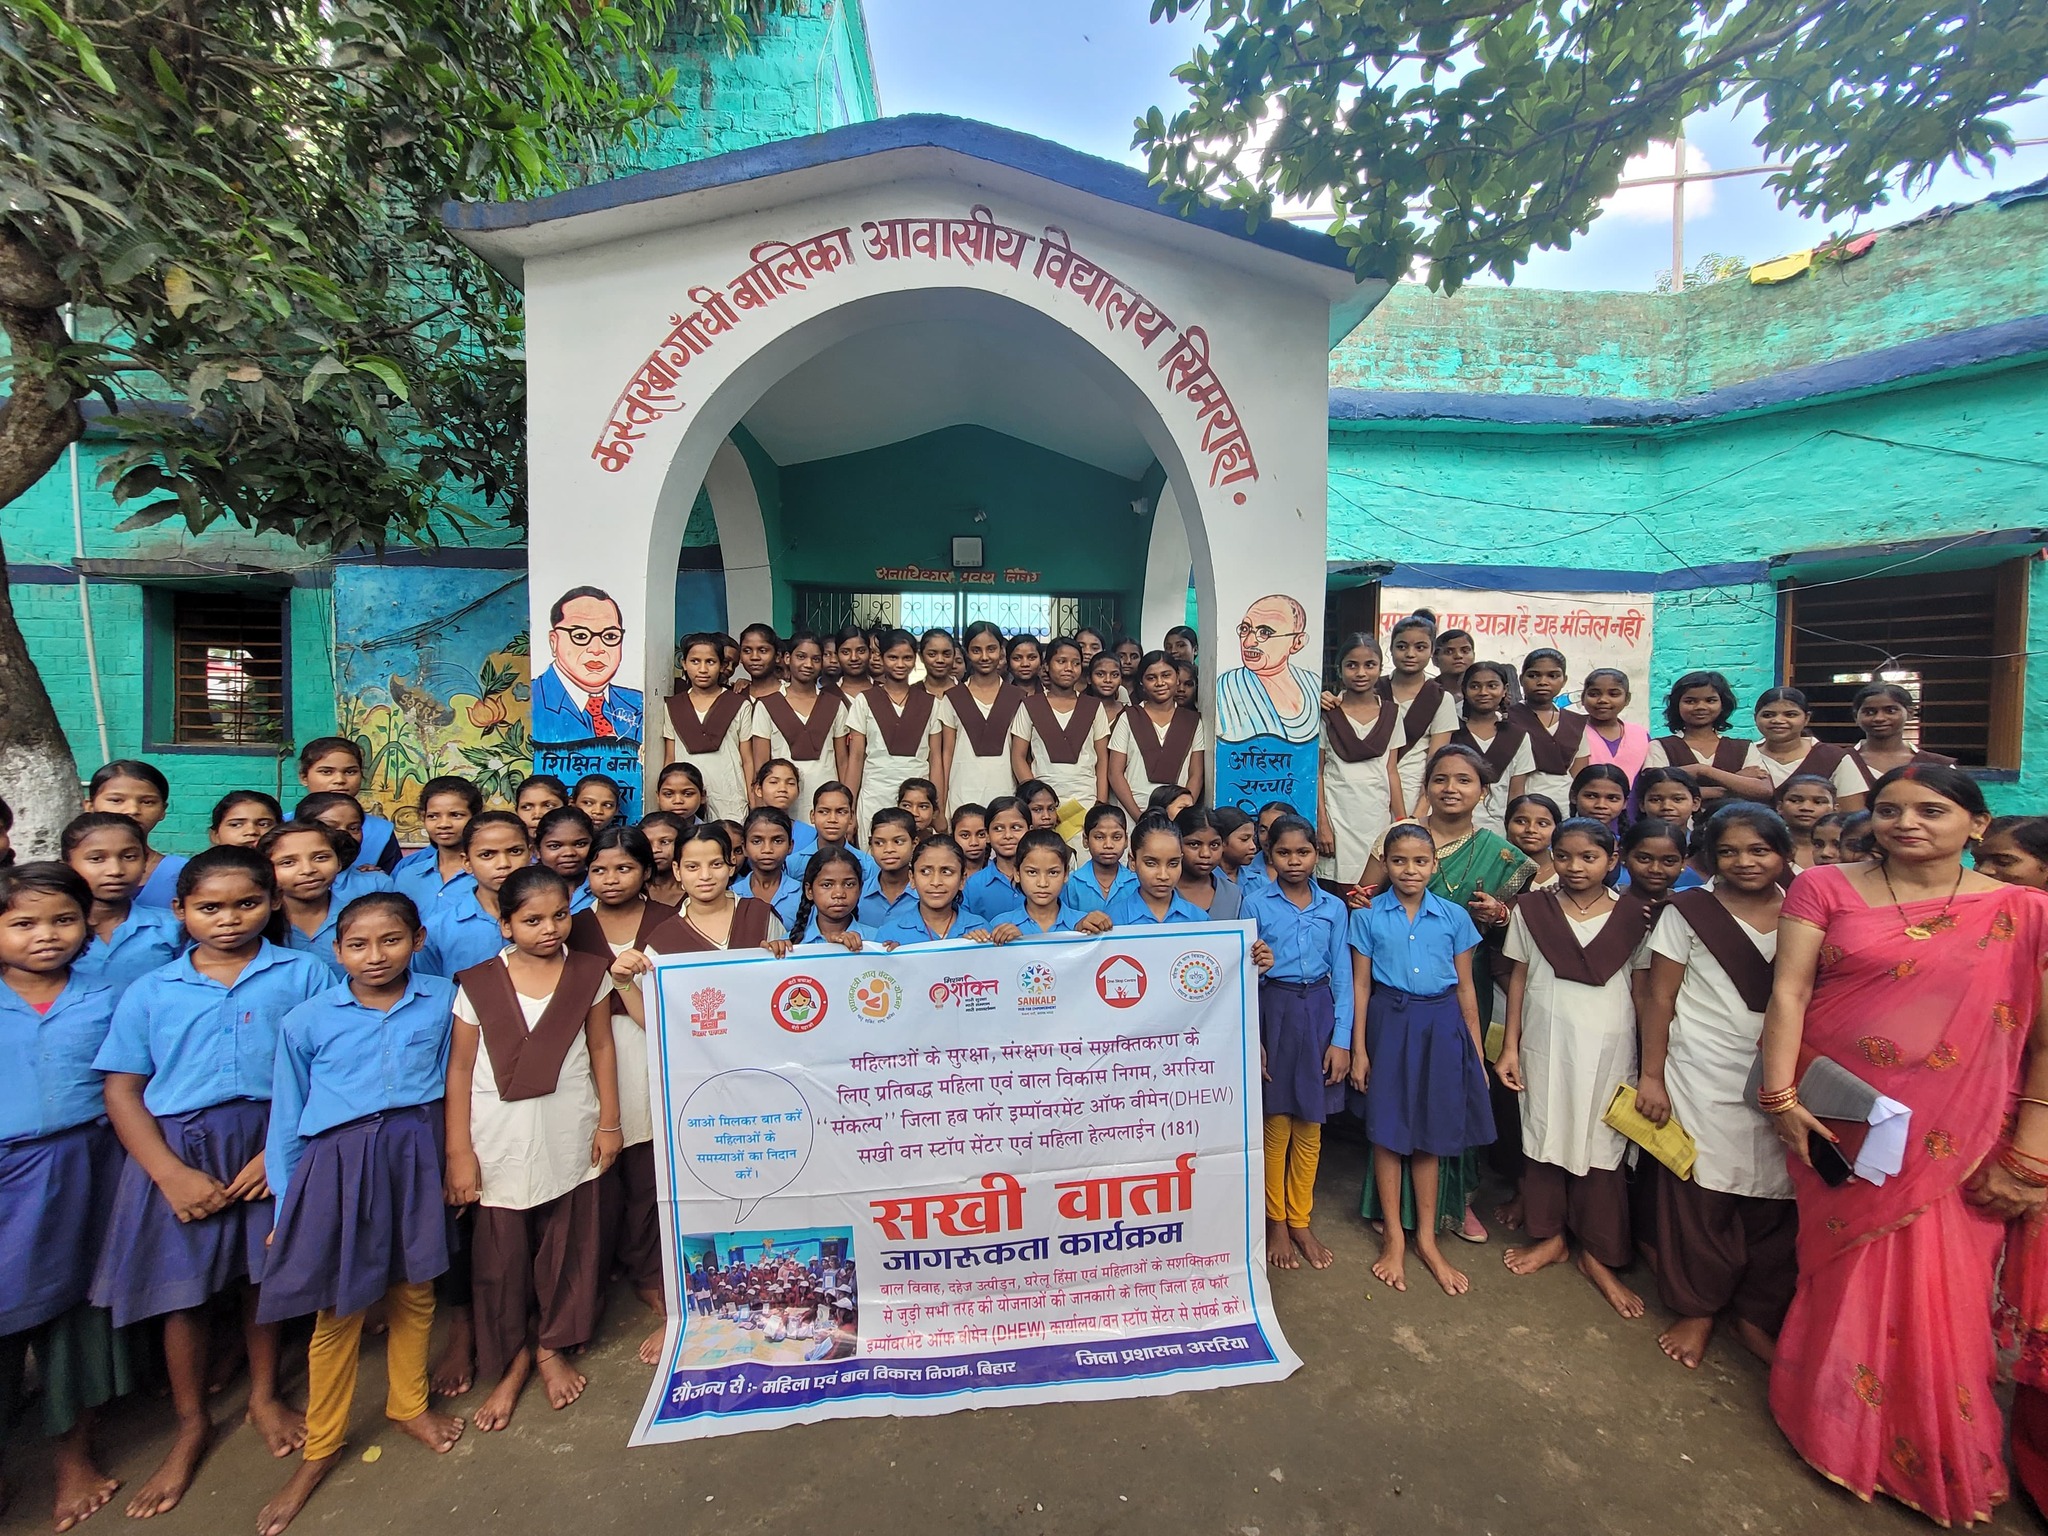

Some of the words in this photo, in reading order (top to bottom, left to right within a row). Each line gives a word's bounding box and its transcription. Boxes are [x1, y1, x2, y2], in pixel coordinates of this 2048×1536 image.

[660, 285, 742, 367] गाँधी
[726, 227, 854, 310] बालिका
[861, 204, 1036, 270] आवासीय
[1033, 224, 1177, 350] विद्यालय
[1447, 614, 1472, 632] एक
[1475, 613, 1517, 637] यात्रा
[1534, 614, 1559, 649] यह
[1560, 609, 1612, 641] मंजिल
[1611, 608, 1646, 648] नहीं
[542, 751, 603, 775] शिक्षित
[607, 750, 639, 773] बनो
[1229, 745, 1293, 774] अहिंसा
[618, 780, 636, 804] रो
[1017, 996, 1056, 1005] SANKALP
[850, 1048, 919, 1073] महिलाओं
[924, 1046, 941, 1064] के
[946, 1047, 996, 1069] सुरक्षा,
[1001, 1040, 1054, 1062] संरक्षण
[1058, 1036, 1082, 1061] एवं
[1087, 1033, 1180, 1056] सशक्तिकरण
[1183, 1027, 1200, 1046] के
[836, 1084, 871, 1106] लिए
[874, 1079, 933, 1102] प्रतिबद्ध
[937, 1074, 984, 1095] महिला
[989, 1070, 1013, 1095] एवं
[1018, 1073, 1051, 1089] बाल
[1056, 1068, 1107, 1087] विकास
[1112, 1063, 1157, 1082] निगम,
[1162, 1057, 1215, 1077] अररिया
[688, 1115, 715, 1128] आओ
[719, 1114, 757, 1127] मिलकर
[761, 1113, 781, 1124] बात
[785, 1109, 802, 1122] करें
[901, 1109, 941, 1129] जिला
[946, 1108, 968, 1127] हब
[972, 1102, 1003, 1123] फॉर
[1008, 1097, 1085, 1125] इम्पॉवरमेंट
[1089, 1094, 1125, 1113] ऑफ
[697, 1150, 744, 1163] समस्याओं
[748, 1151, 763, 1161] का
[767, 1148, 797, 1161] निदान
[714, 1131, 760, 1146] महिलाओं
[764, 1130, 776, 1142] के
[857, 1141, 894, 1165] सखी
[899, 1144, 923, 1159] वन
[928, 1136, 965, 1158] स्टॉप
[969, 1133, 1003, 1155] सेंटर
[1008, 1131, 1034, 1156] एवं
[1038, 1128, 1084, 1149] महिला
[1088, 1118, 1155, 1146] हेल्पलाईन
[1161, 1119, 1200, 1141] (181)
[870, 1172, 1027, 1241] सखी
[1054, 1152, 1197, 1222] वार्ता
[880, 1237, 1049, 1271] जागरूकता
[1058, 1220, 1184, 1257] कार्यक्रम
[880, 1283, 903, 1296] बाल
[908, 1280, 945, 1295] विवाह,
[948, 1279, 972, 1294] दहेज
[1024, 1271, 1051, 1289] घरेलू
[1054, 1268, 1077, 1284] हिंसा
[1081, 1265, 1097, 1284] एवं
[1101, 1258, 1148, 1278] महिलाओं
[1151, 1256, 1163, 1272] के
[1166, 1252, 1230, 1270] सशक्तिकरण
[883, 1306, 893, 1324] से
[897, 1304, 921, 1327] जुड़ी
[924, 1303, 949, 1319] सभी
[953, 1300, 975, 1317] तरह
[978, 1296, 993, 1314] की
[997, 1291, 1047, 1311] योजनाओं
[1050, 1289, 1066, 1307] की
[1069, 1284, 1116, 1304] जानकारी
[1119, 1284, 1131, 1299] के
[1135, 1283, 1158, 1299] लिए
[1160, 1280, 1187, 1294] जिला
[1190, 1278, 1205, 1293] हब
[1209, 1275, 1230, 1290] फॉर
[927, 1329, 955, 1347] ऑफ
[957, 1324, 988, 1344] वीमेन
[992, 1320, 1046, 1345] (DHEW)
[1122, 1308, 1148, 1327] स्टॉप
[1151, 1305, 1175, 1323] सेंटर
[1178, 1303, 1188, 1320] से
[1192, 1298, 1220, 1318] संपर्क
[1075, 1350, 1118, 1366] जिला
[1120, 1343, 1184, 1365] प्रशासन
[1187, 1336, 1249, 1355] अररिया
[672, 1380, 725, 1403] सौजन्य
[730, 1374, 743, 1395] से
[762, 1375, 810, 1394] महिला
[814, 1370, 838, 1390] एवं
[841, 1366, 869, 1382] बाल
[873, 1365, 921, 1381] विकास
[925, 1362, 974, 1380] निगम,
[977, 1361, 1017, 1375] बिहार
